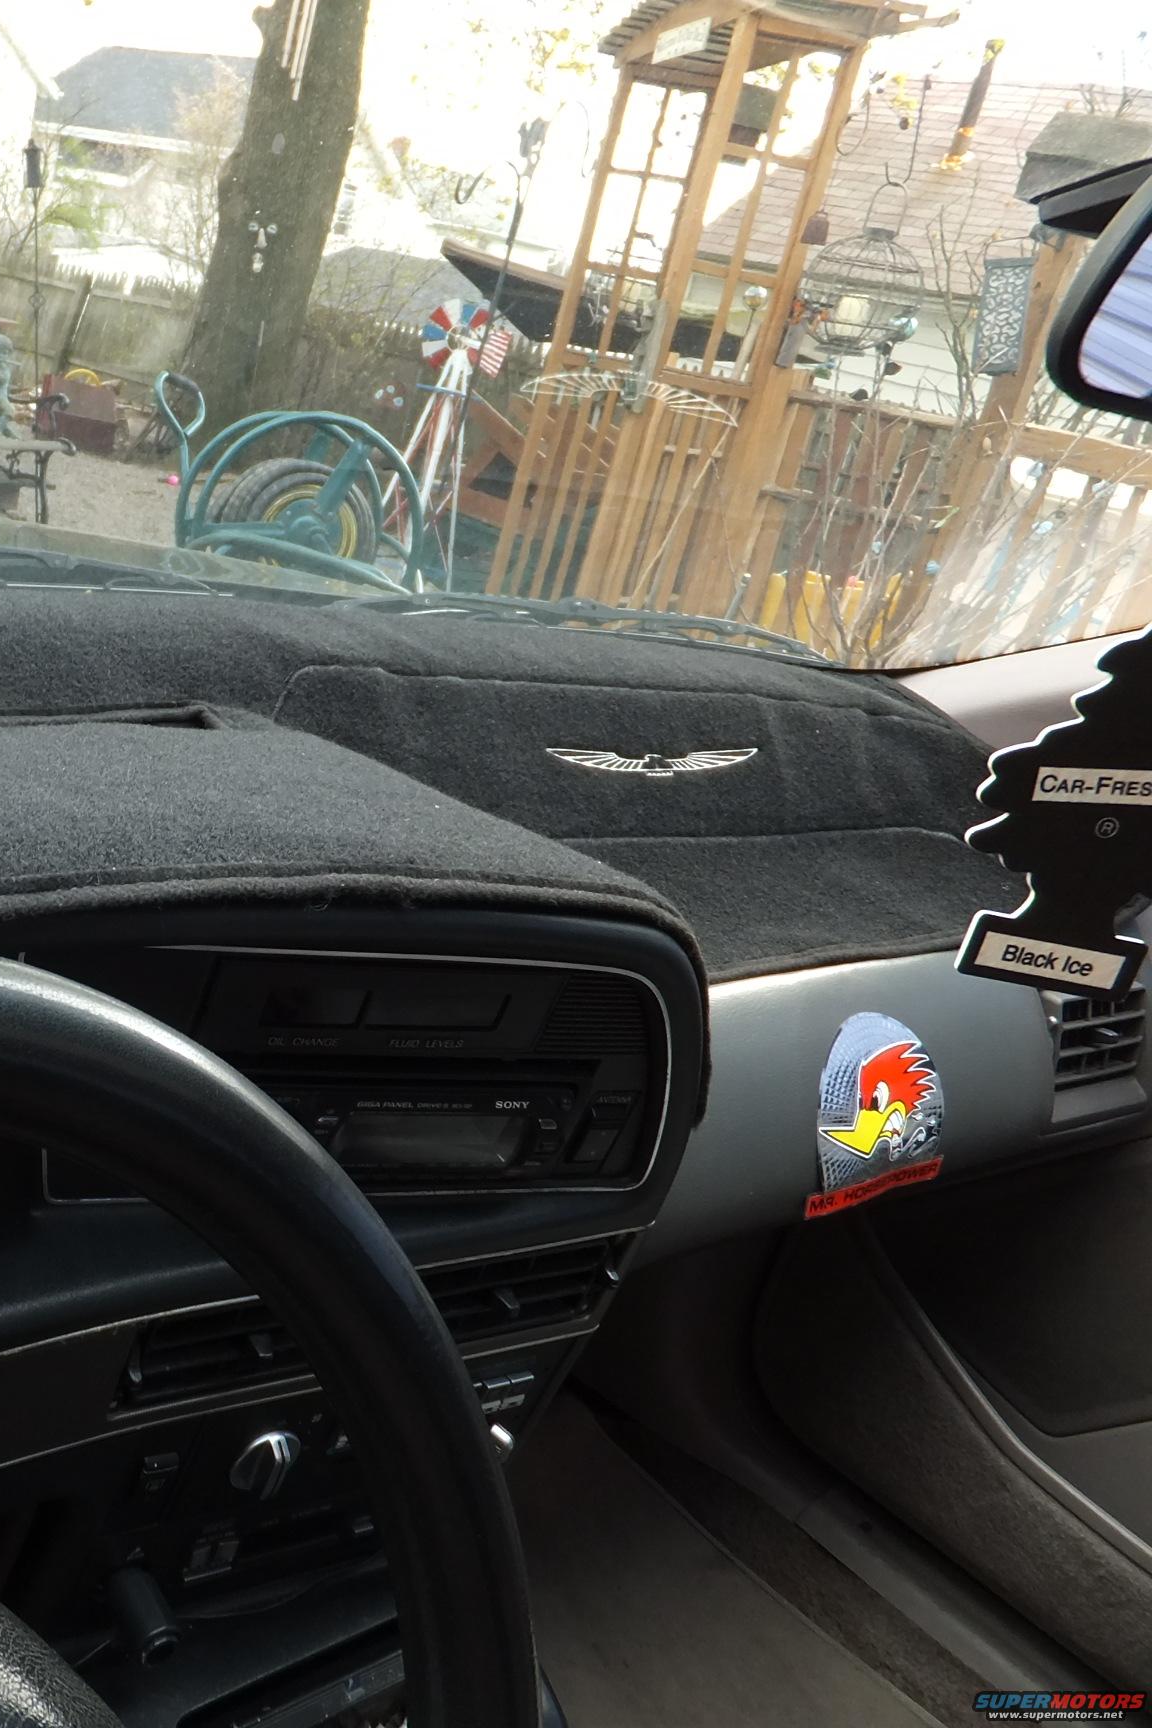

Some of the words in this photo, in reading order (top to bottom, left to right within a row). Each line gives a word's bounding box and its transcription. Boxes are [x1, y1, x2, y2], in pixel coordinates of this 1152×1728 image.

[1001, 944, 1056, 970] Black
[1061, 955, 1094, 977] Ice
[267, 1036, 286, 1047] OIL
[292, 1037, 340, 1048] CHANGE
[388, 1039, 420, 1049] FLUID
[425, 1039, 465, 1049] LEVELS
[383, 1102, 414, 1110] PANEL
[495, 1100, 531, 1110] SONY
